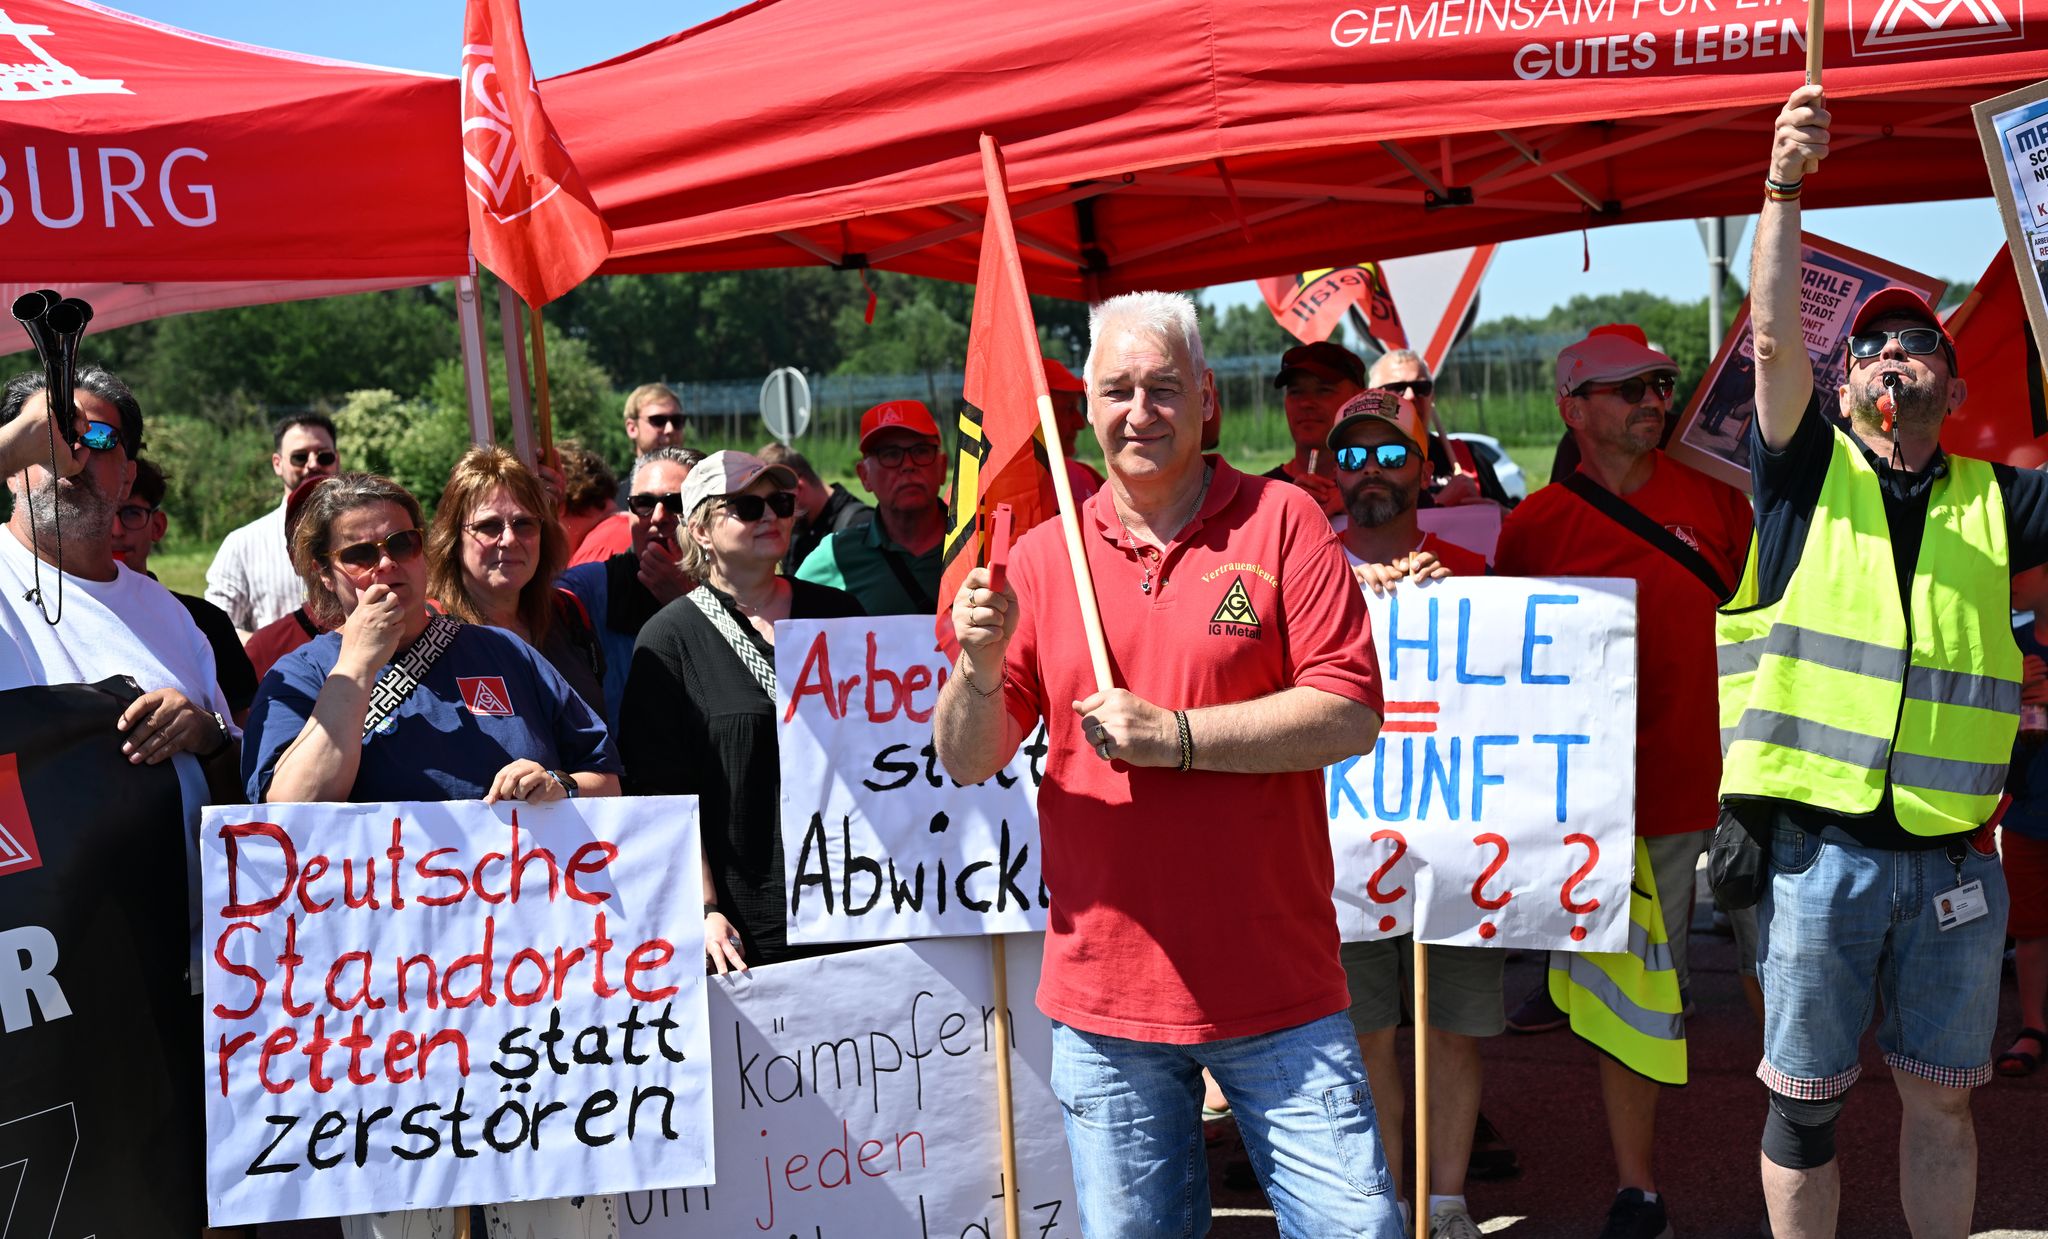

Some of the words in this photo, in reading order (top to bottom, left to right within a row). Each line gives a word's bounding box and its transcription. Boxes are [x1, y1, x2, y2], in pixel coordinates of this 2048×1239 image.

[1330, 0, 1608, 48] GEMEINSAM
[1512, 31, 1657, 81] GUTES
[1673, 17, 1810, 66] LEBEN
[1801, 287, 1841, 309] HLIESST
[1801, 301, 1835, 323] STADT.
[1801, 316, 1825, 332] UNFT
[1201, 562, 1279, 589] Vertrauensleute
[783, 631, 948, 724] Arbe
[1208, 623, 1222, 636] IG
[1225, 624, 1262, 641] Metall
[1388, 593, 1579, 686] HLE
[1323, 734, 1591, 823] KUNFT
[219, 809, 620, 918] Deutsche
[213, 912, 680, 1020] Standorte
[217, 1013, 471, 1097] retten
[489, 1003, 686, 1080] statt
[735, 990, 1017, 1114] kämpfen
[245, 1082, 680, 1176] zerstören
[756, 1120, 925, 1229] jeden
